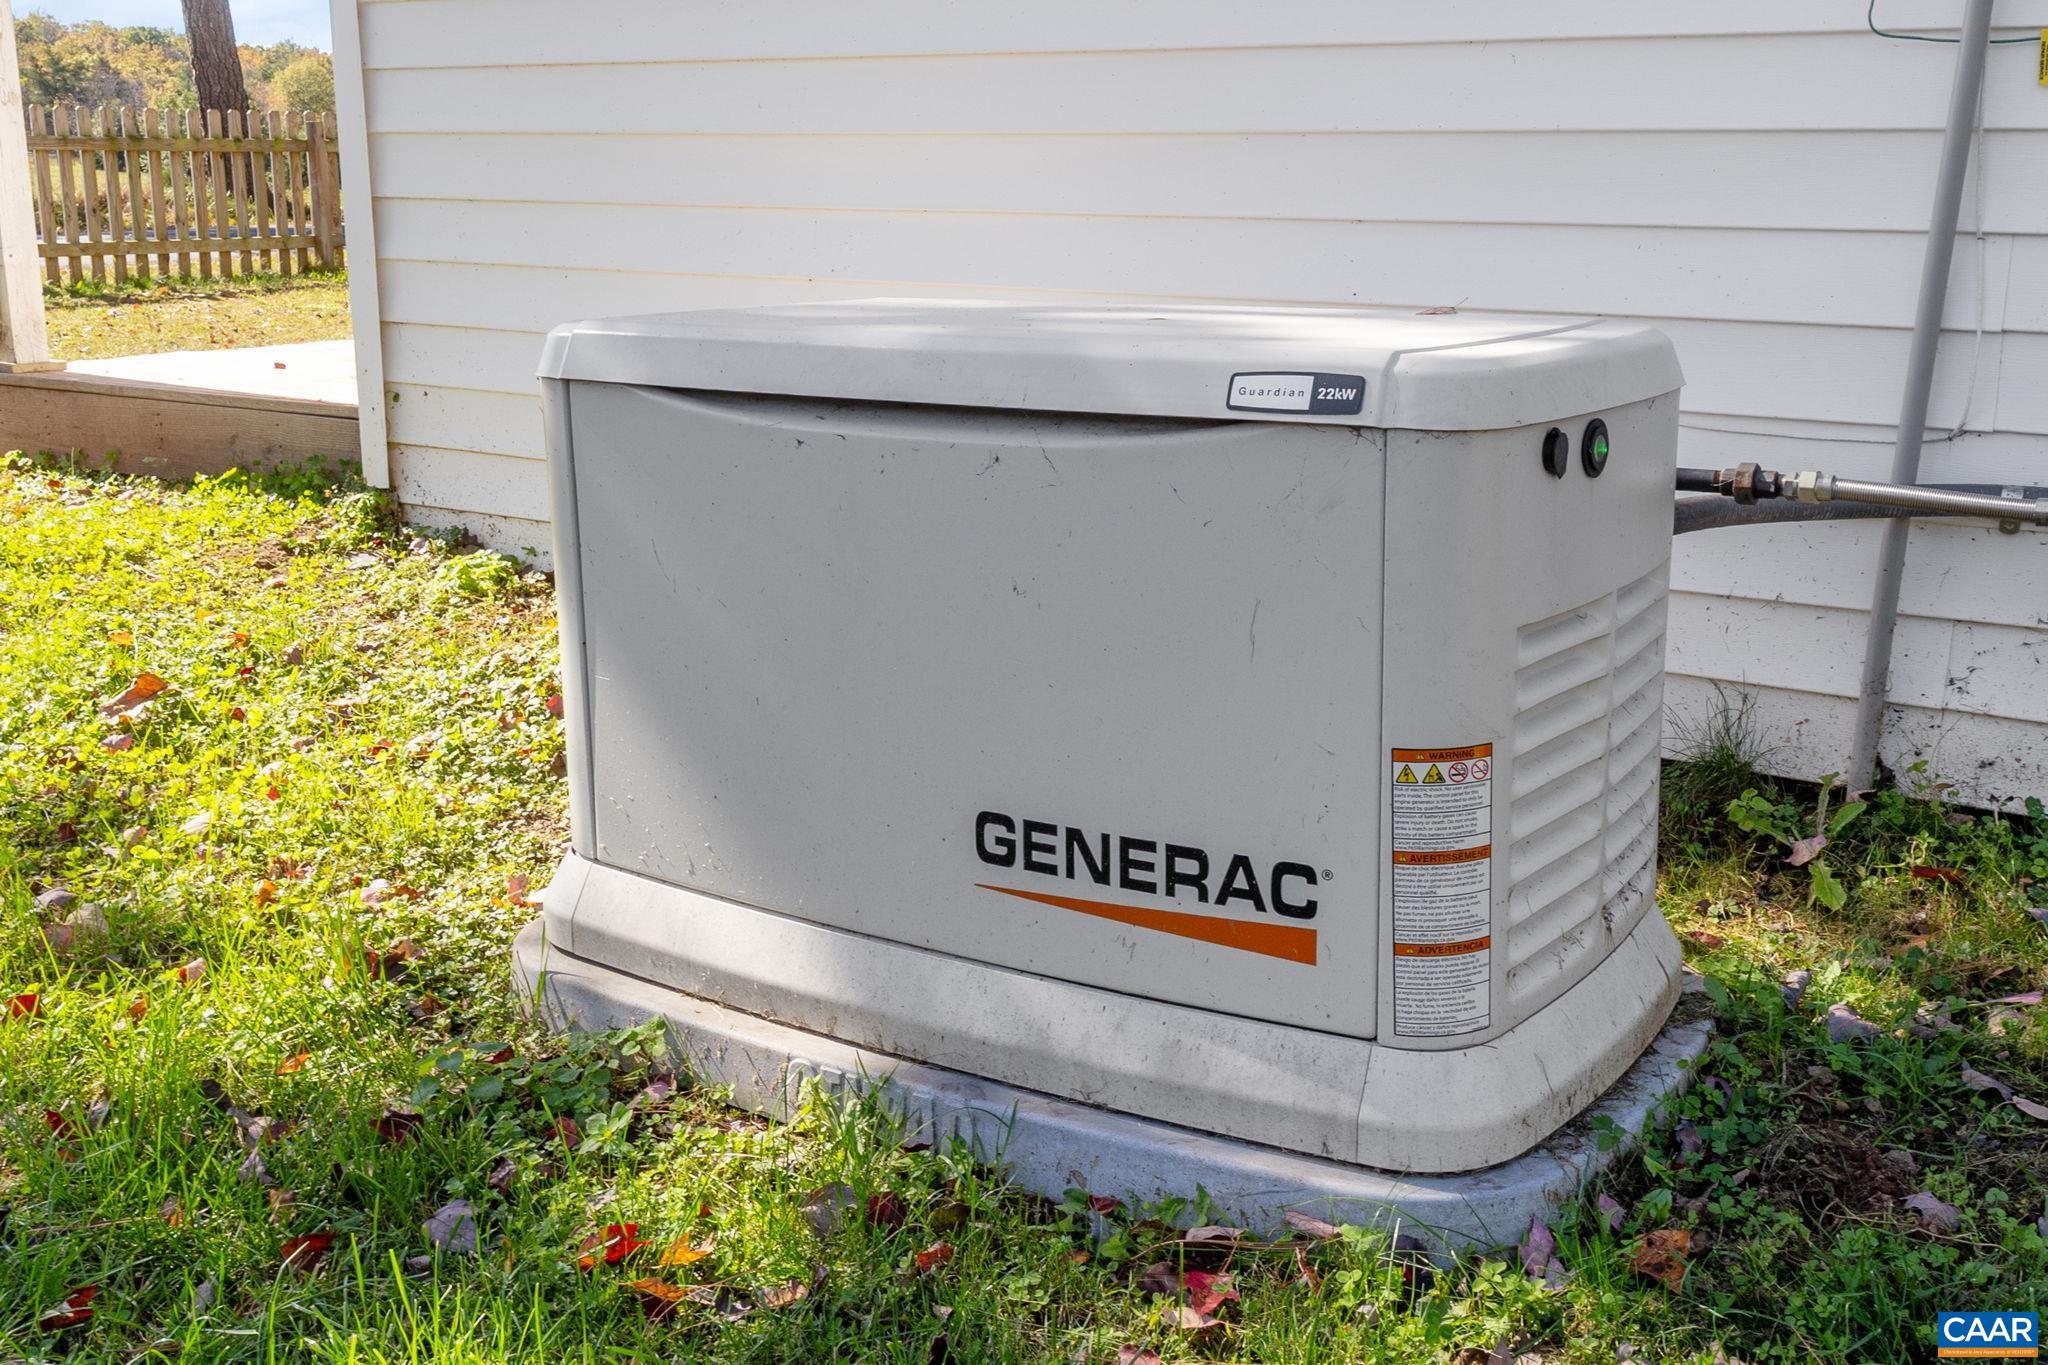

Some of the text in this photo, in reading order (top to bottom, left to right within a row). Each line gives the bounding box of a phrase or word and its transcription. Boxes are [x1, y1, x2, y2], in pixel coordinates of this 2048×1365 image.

[1238, 386, 1357, 401] Guardian 22kW
[1429, 749, 1475, 760] WARNING
[1410, 848, 1488, 863] AVERTISSEMENT
[1418, 941, 1484, 954] ADVERTENCIA
